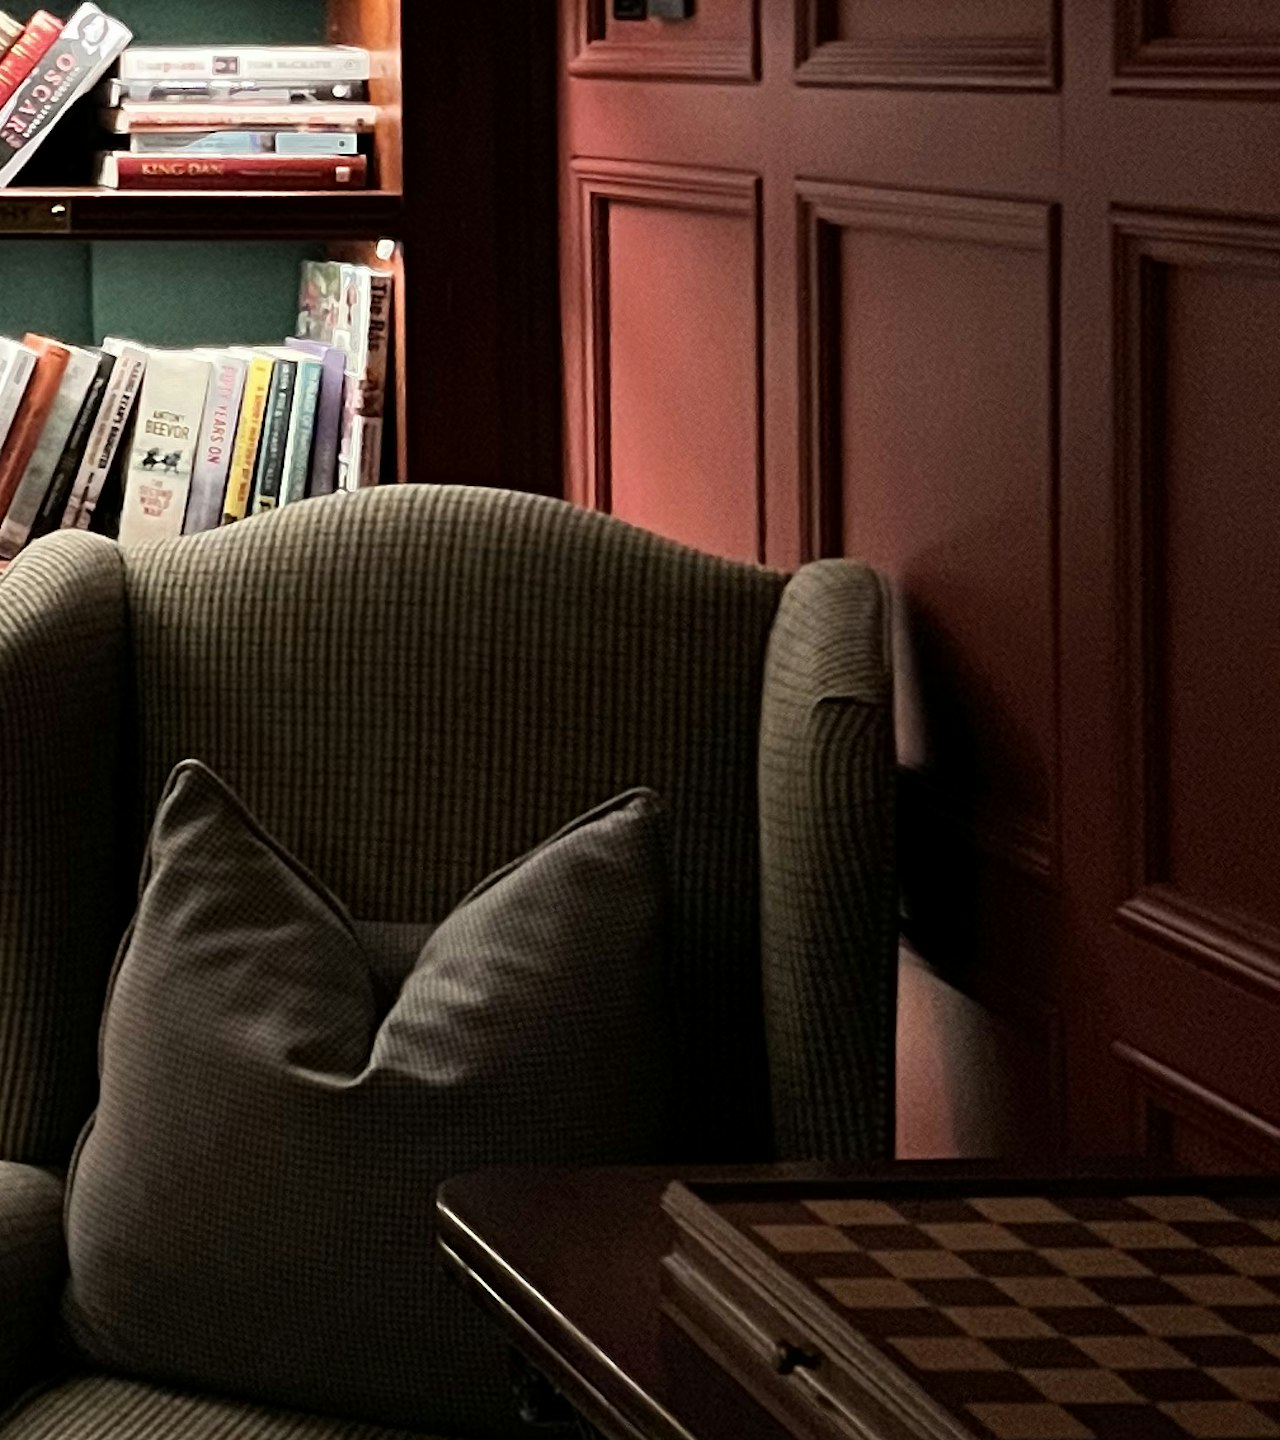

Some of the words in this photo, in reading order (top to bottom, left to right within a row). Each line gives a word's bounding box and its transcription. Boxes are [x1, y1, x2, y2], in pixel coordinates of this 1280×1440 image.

[8, 51, 79, 134] OSCAR
[141, 163, 184, 176] KING
[145, 419, 190, 440] BEEVOR
[210, 405, 229, 444] YEARS
[206, 446, 221, 466] ON
